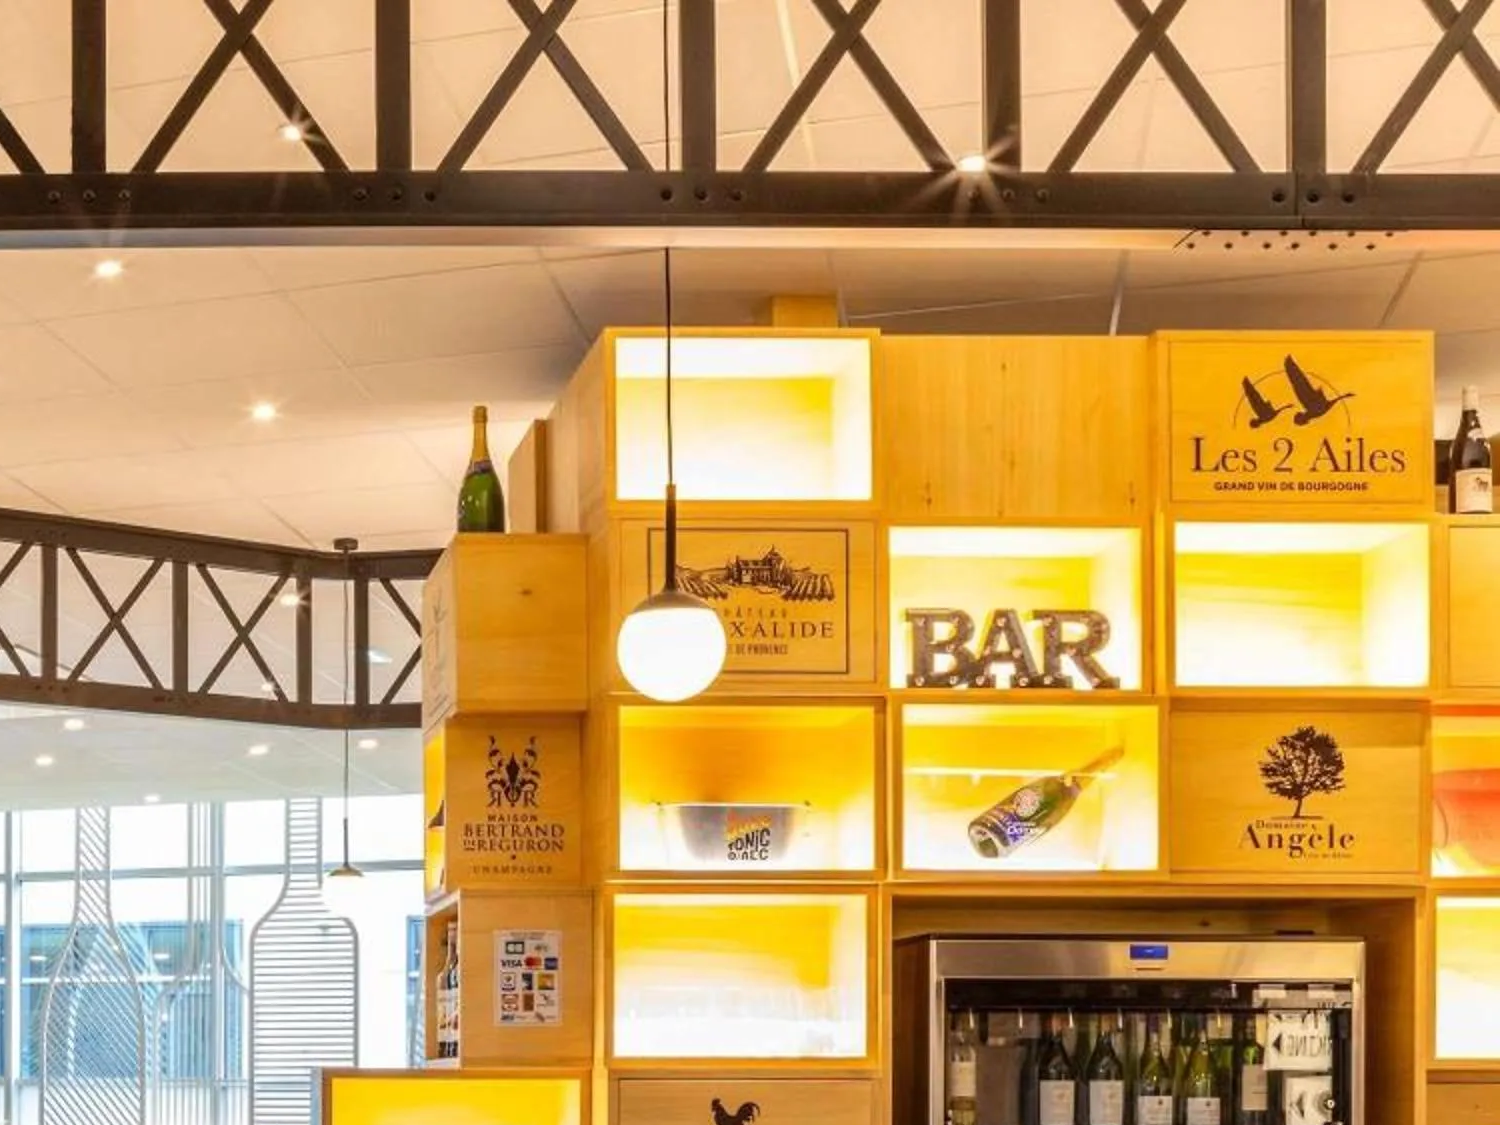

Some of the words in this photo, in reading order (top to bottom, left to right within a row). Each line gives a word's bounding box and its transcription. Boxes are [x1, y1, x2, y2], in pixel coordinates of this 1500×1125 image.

[1190, 436, 1258, 472] Les
[1273, 436, 1294, 473] 2
[1309, 436, 1406, 472] Ailes
[1214, 481, 1253, 491] GRAND
[1257, 481, 1277, 491] VIN
[1280, 481, 1295, 491] DE
[1298, 481, 1368, 491] BOURGOGNE
[905, 607, 1121, 689] BAR
[487, 814, 538, 822] MAISON
[464, 823, 565, 838] BERTRAND
[728, 828, 771, 852] TONIC
